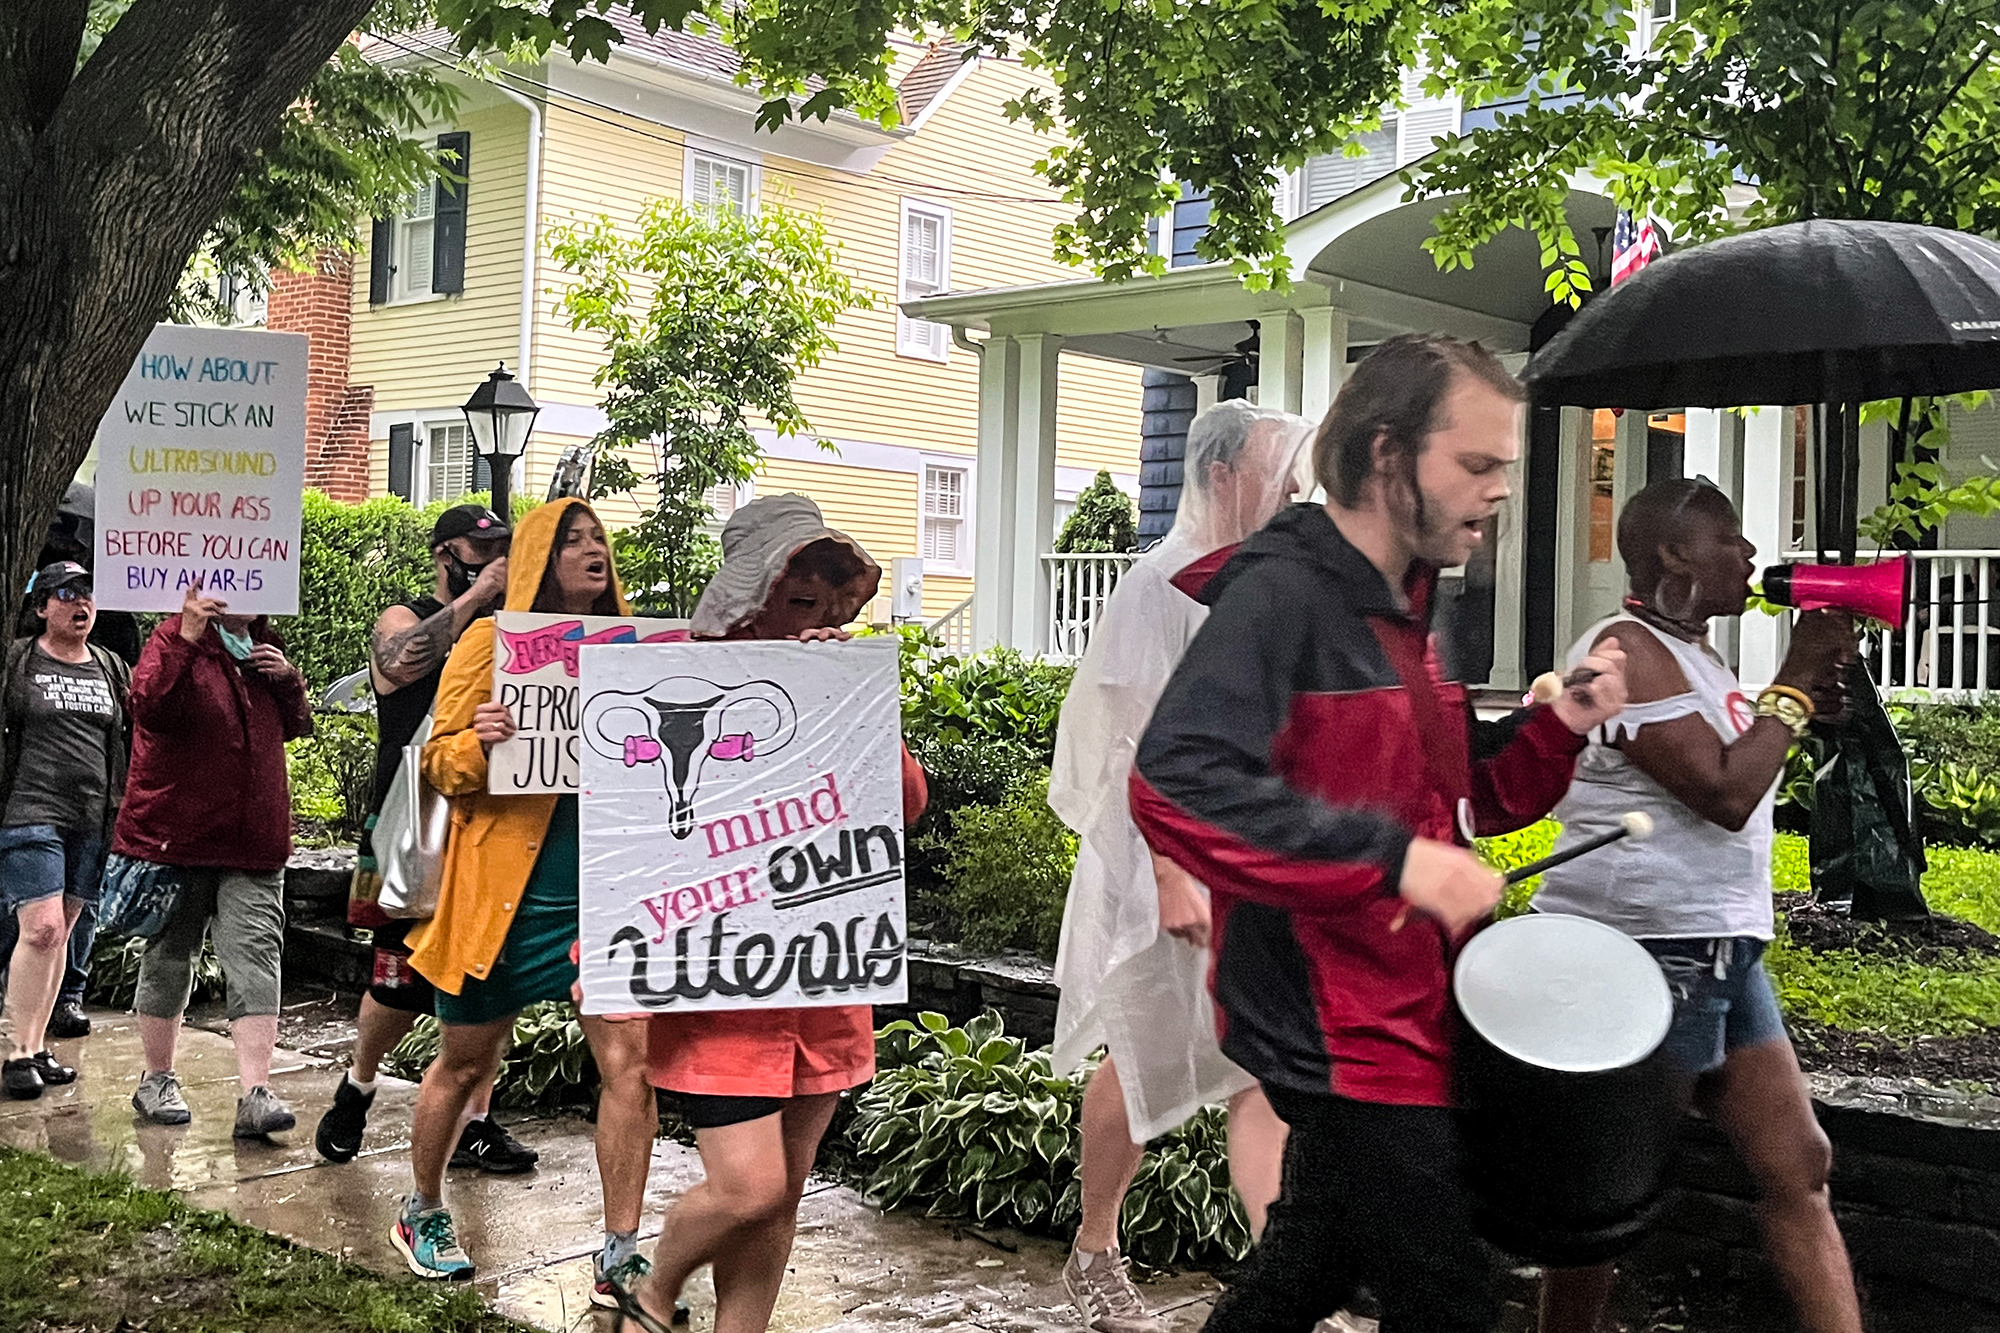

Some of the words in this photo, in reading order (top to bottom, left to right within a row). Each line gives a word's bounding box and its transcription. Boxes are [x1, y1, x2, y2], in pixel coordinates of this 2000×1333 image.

[141, 353, 193, 381] HOW
[198, 357, 279, 386] ABOUT
[124, 400, 167, 427] WE
[174, 402, 239, 427] STICK
[244, 404, 274, 428] AN
[128, 445, 277, 477] ULTRASOUND
[128, 488, 162, 517] UP
[171, 490, 222, 519] YOUR
[231, 495, 272, 522] ASS
[105, 529, 193, 557] BEFORE
[202, 533, 244, 560] YOU
[247, 536, 289, 562] CAN
[126, 565, 169, 590] BUY
[175, 567, 206, 592] AN
[209, 568, 264, 592] AR-15
[61, 691, 77, 702] YOU
[65, 701, 93, 712] FOSTER
[700, 772, 849, 858] mind
[640, 866, 759, 945] your
[607, 911, 906, 1008] uterus
